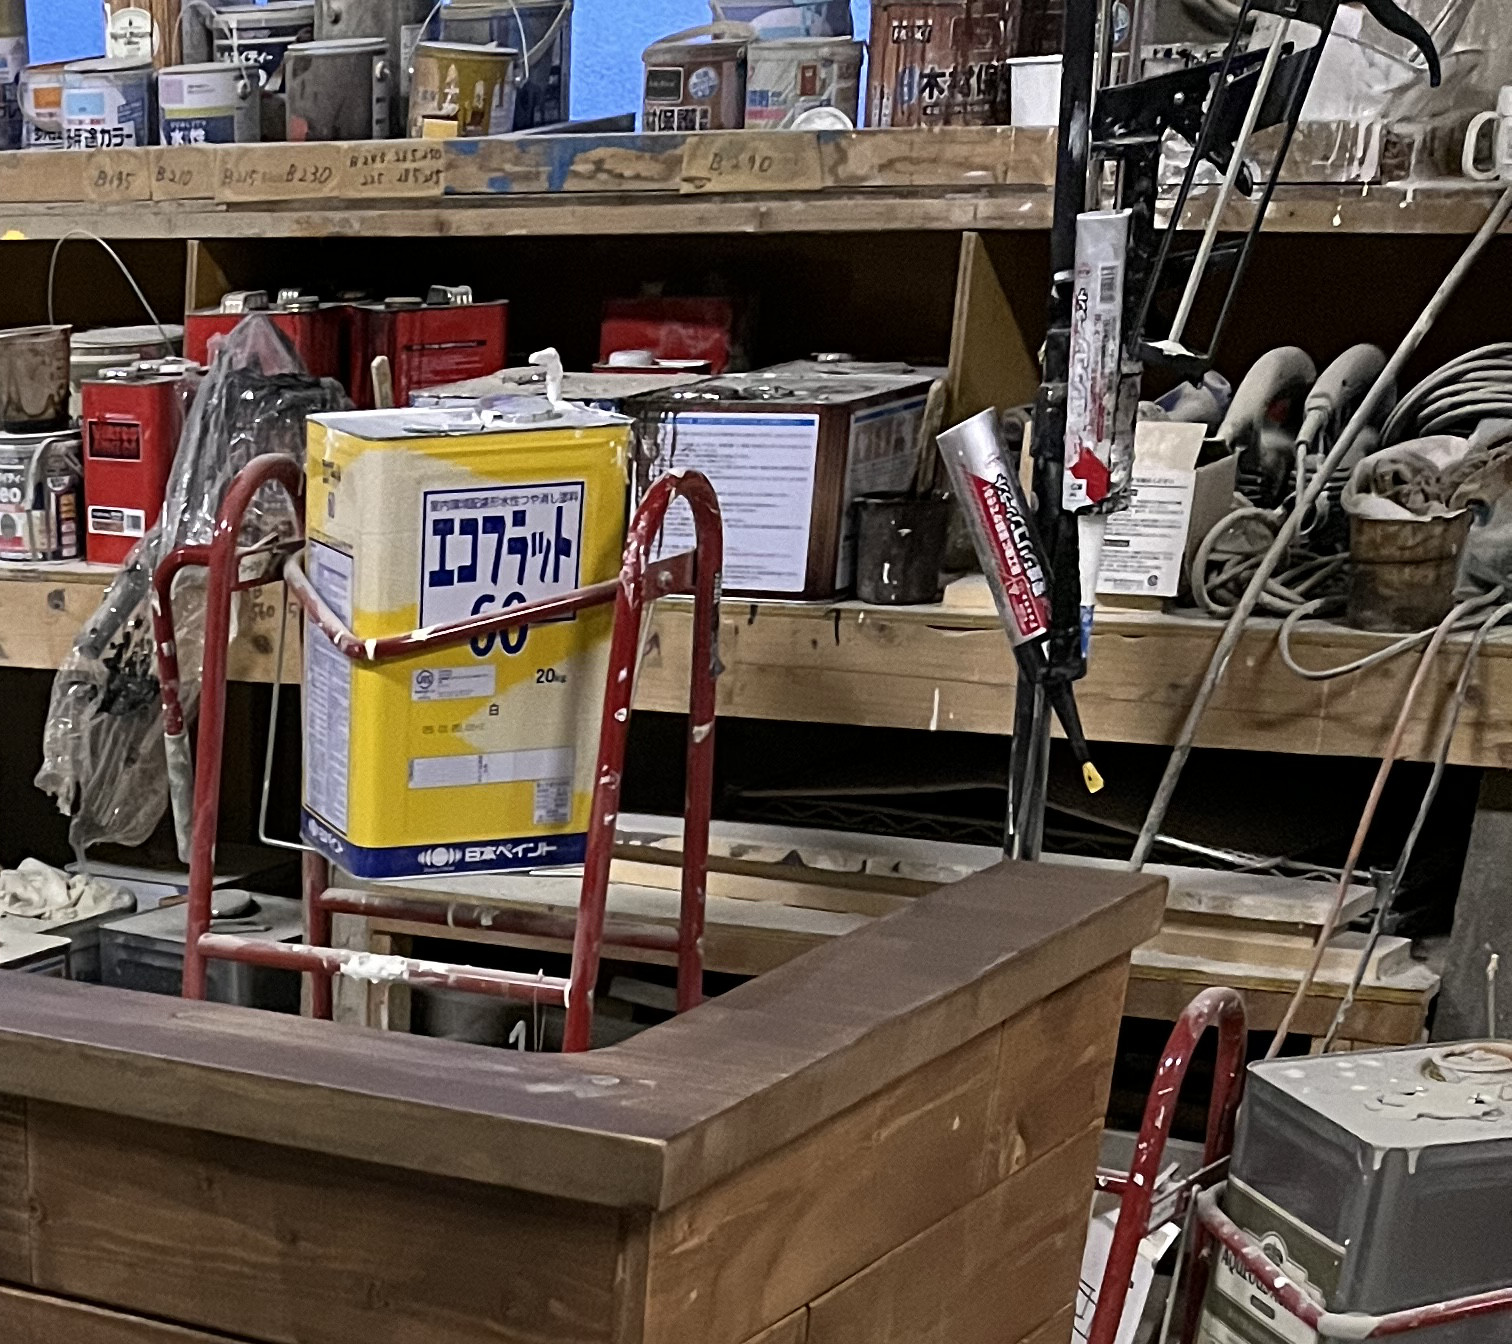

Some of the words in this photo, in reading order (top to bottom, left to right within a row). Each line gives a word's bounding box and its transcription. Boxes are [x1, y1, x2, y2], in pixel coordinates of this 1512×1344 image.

[429, 505, 573, 588] エコフラット
[464, 843, 558, 863] 日本ペイント
